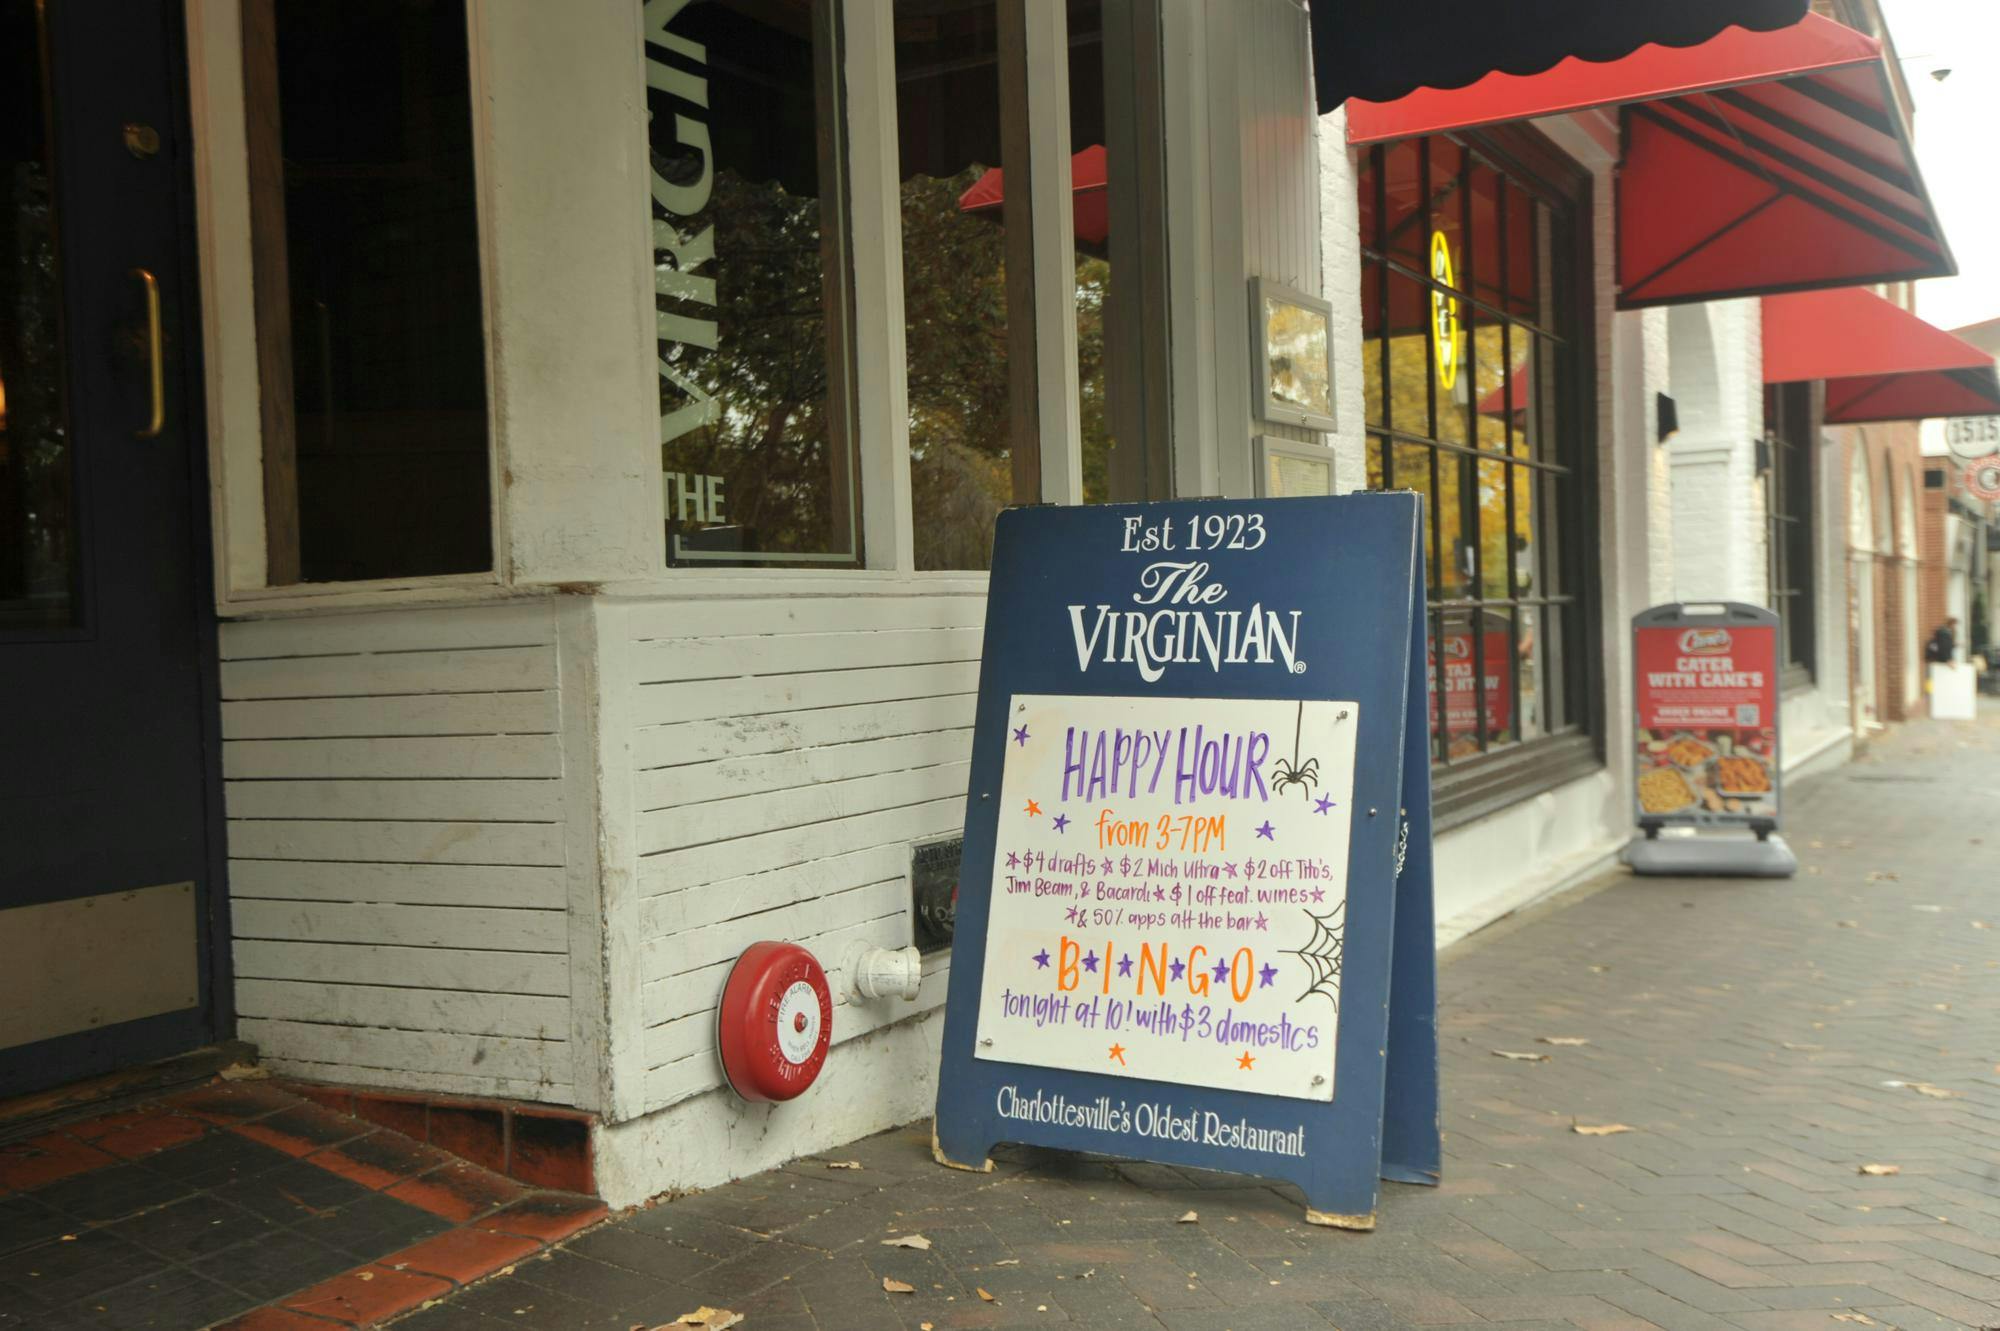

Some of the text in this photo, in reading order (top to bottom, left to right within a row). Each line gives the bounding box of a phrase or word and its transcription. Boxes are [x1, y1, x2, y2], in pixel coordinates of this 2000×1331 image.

[662, 471, 725, 523] THE
[1120, 514, 1267, 553] Est 1923
[1133, 561, 1228, 605] The
[1648, 672, 1697, 688] WITH
[1676, 657, 1733, 672] CATER
[1061, 724, 1269, 804] HAPPY HOUR
[1094, 808, 1226, 853] from 3-7PM
[1023, 848, 1045, 874] $4
[1047, 851, 1096, 877] drafts
[1119, 855, 1144, 878] $2
[1147, 857, 1178, 878] Mich
[1184, 857, 1220, 880] Ultra
[1243, 857, 1267, 881] $2
[1270, 860, 1294, 880] off
[1005, 876, 1032, 894] Jim
[1080, 880, 1091, 898] &
[1196, 885, 1218, 907] off
[1257, 888, 1309, 905] wines
[1093, 907, 1124, 927] 50%
[1128, 913, 1167, 931] apps
[1198, 910, 1223, 930] the
[1227, 910, 1254, 931] bar
[1001, 988, 1071, 1028] tonight
[1075, 995, 1100, 1029] at
[1136, 1001, 1178, 1037] with
[1179, 1003, 1213, 1043] $3
[1216, 1007, 1319, 1053] domestics
[997, 1085, 1306, 1157] Charlottesville's Oldest Restaurant
